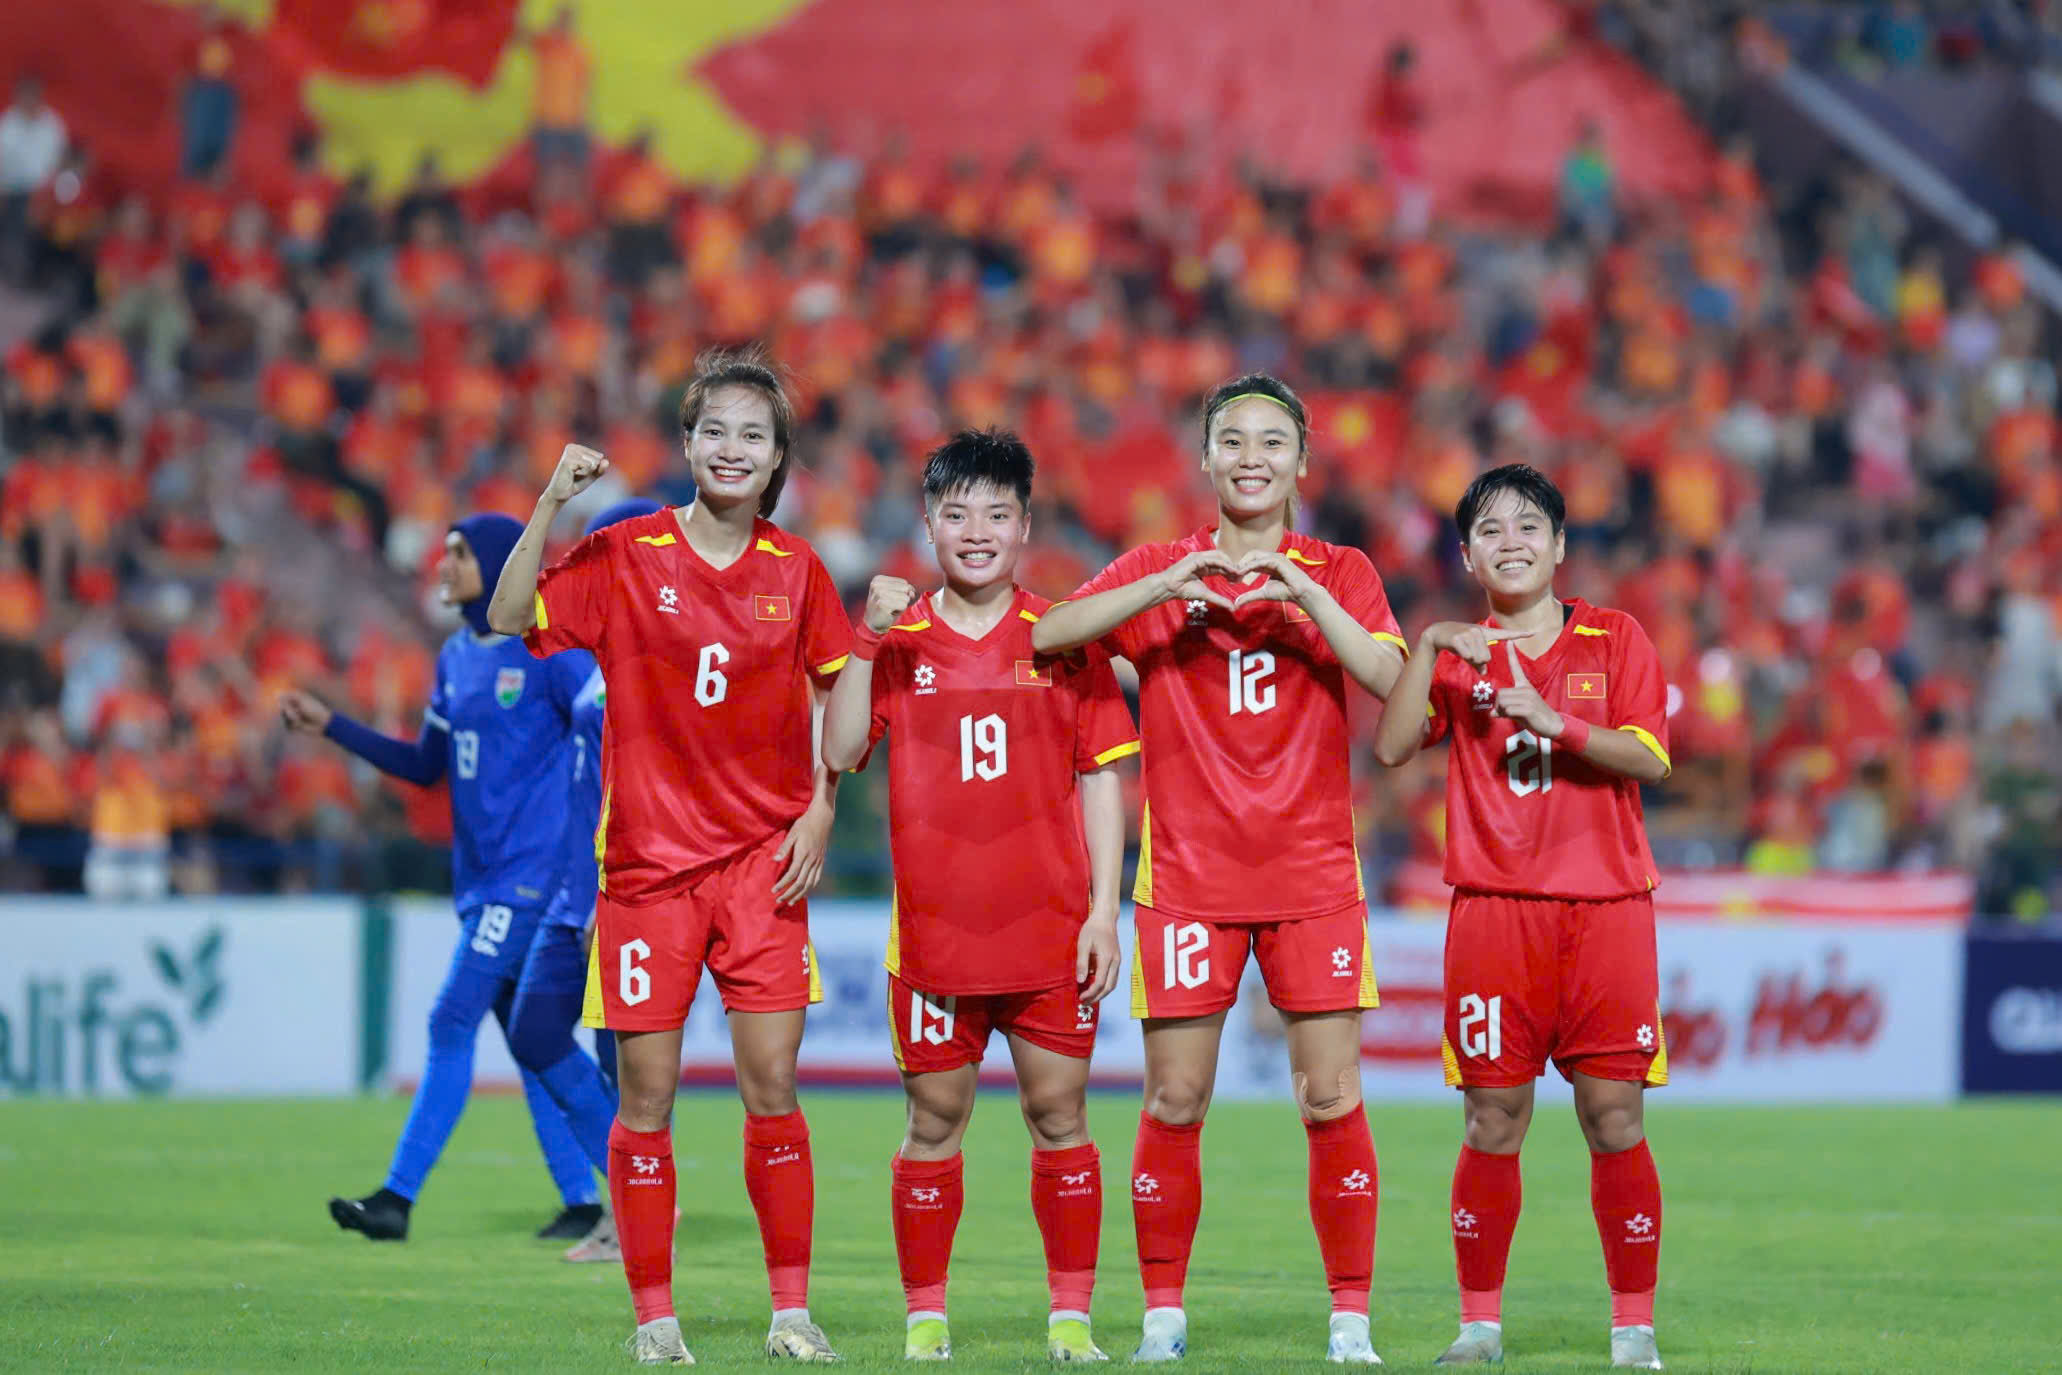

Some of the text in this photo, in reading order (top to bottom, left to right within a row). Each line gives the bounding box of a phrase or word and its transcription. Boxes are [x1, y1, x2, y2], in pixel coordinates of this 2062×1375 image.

[694, 642, 730, 708] 6
[1228, 648, 1277, 716] 12
[959, 712, 1008, 783] 19
[1505, 728, 1553, 798] 21
[619, 937, 651, 1007] 6
[1163, 921, 1210, 990] 12
[0, 970, 181, 1091] life
[1459, 993, 1501, 1061] 21
